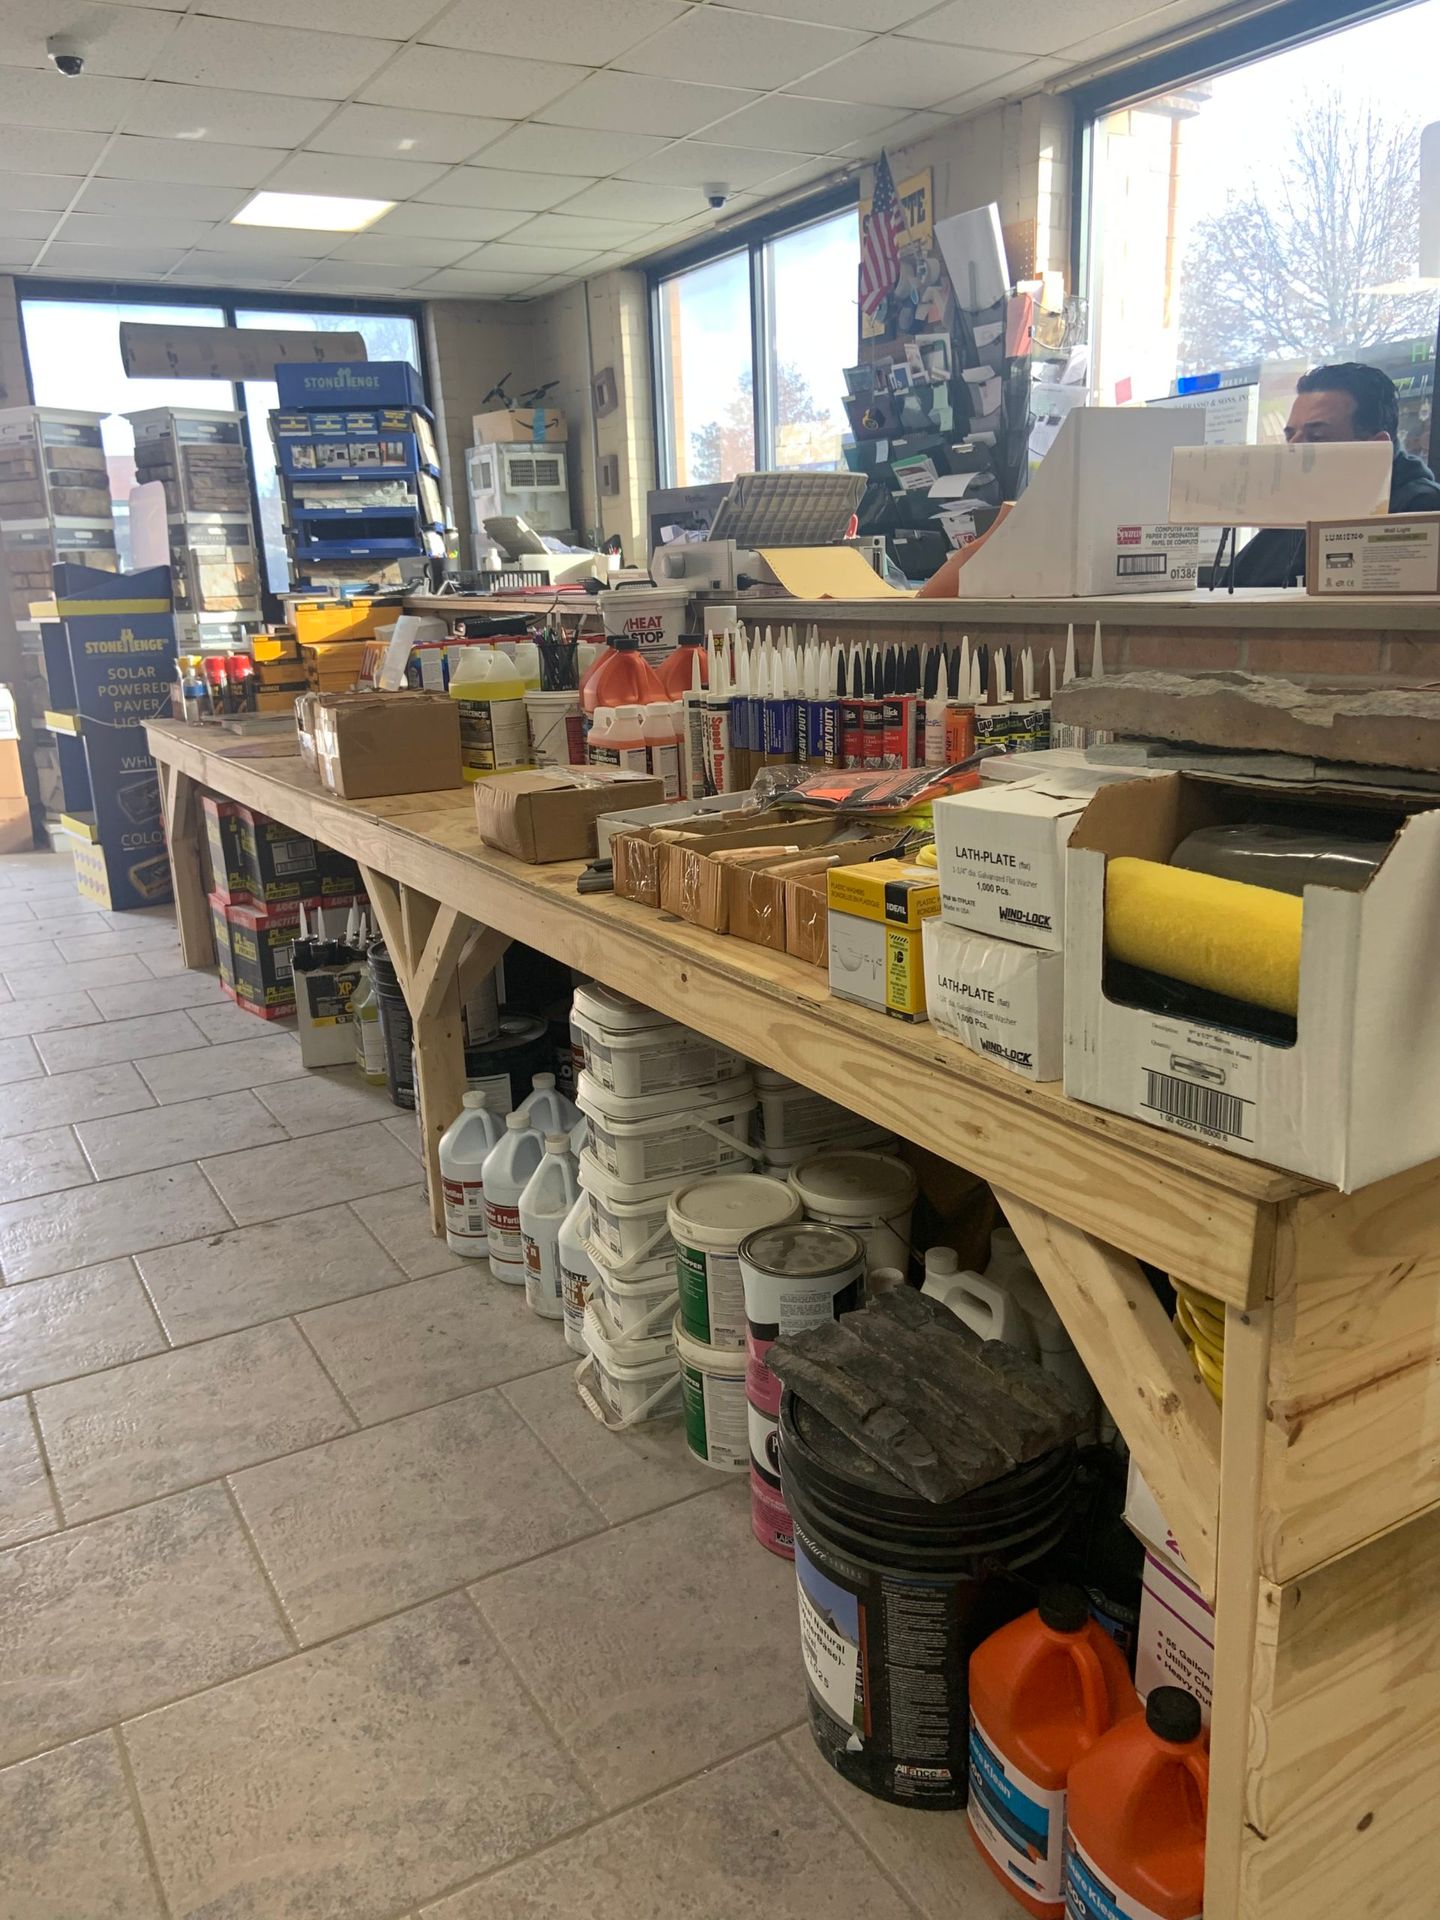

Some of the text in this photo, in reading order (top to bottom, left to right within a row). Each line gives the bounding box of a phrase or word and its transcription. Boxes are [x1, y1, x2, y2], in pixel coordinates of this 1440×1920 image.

[303, 368, 380, 388] STONEHENGE
[629, 616, 662, 630] HEAT
[85, 628, 164, 654] STONEHENGE
[631, 631, 664, 643] STOP
[108, 666, 156, 680] SOLAR
[98, 681, 169, 697] POWERED
[114, 699, 159, 713] PAVER
[712, 716, 724, 752] Speed
[798, 706, 806, 762] HEAVY DUTY
[825, 707, 834, 764] HEAVY DUTY
[978, 720, 993, 732] DAP
[955, 846, 1016, 868] LATH-PLATE
[976, 881, 1012, 897] 1,000 Pcs.
[886, 902, 907, 915] IDEAL
[999, 905, 1052, 927] WIND-LOCK
[338, 981, 352, 996] XP
[937, 974, 995, 1004] LATH-PLATE
[974, 1018, 990, 1031] Pcs.
[980, 1037, 1033, 1064] WIND-LOCK
[1165, 1636, 1211, 1681] 55 Gallon
[1165, 1648, 1192, 1678] Utility
[1164, 1660, 1192, 1695] Heavy
[894, 1763, 937, 1778] Alliance
[983, 1759, 1011, 1800] Klean
